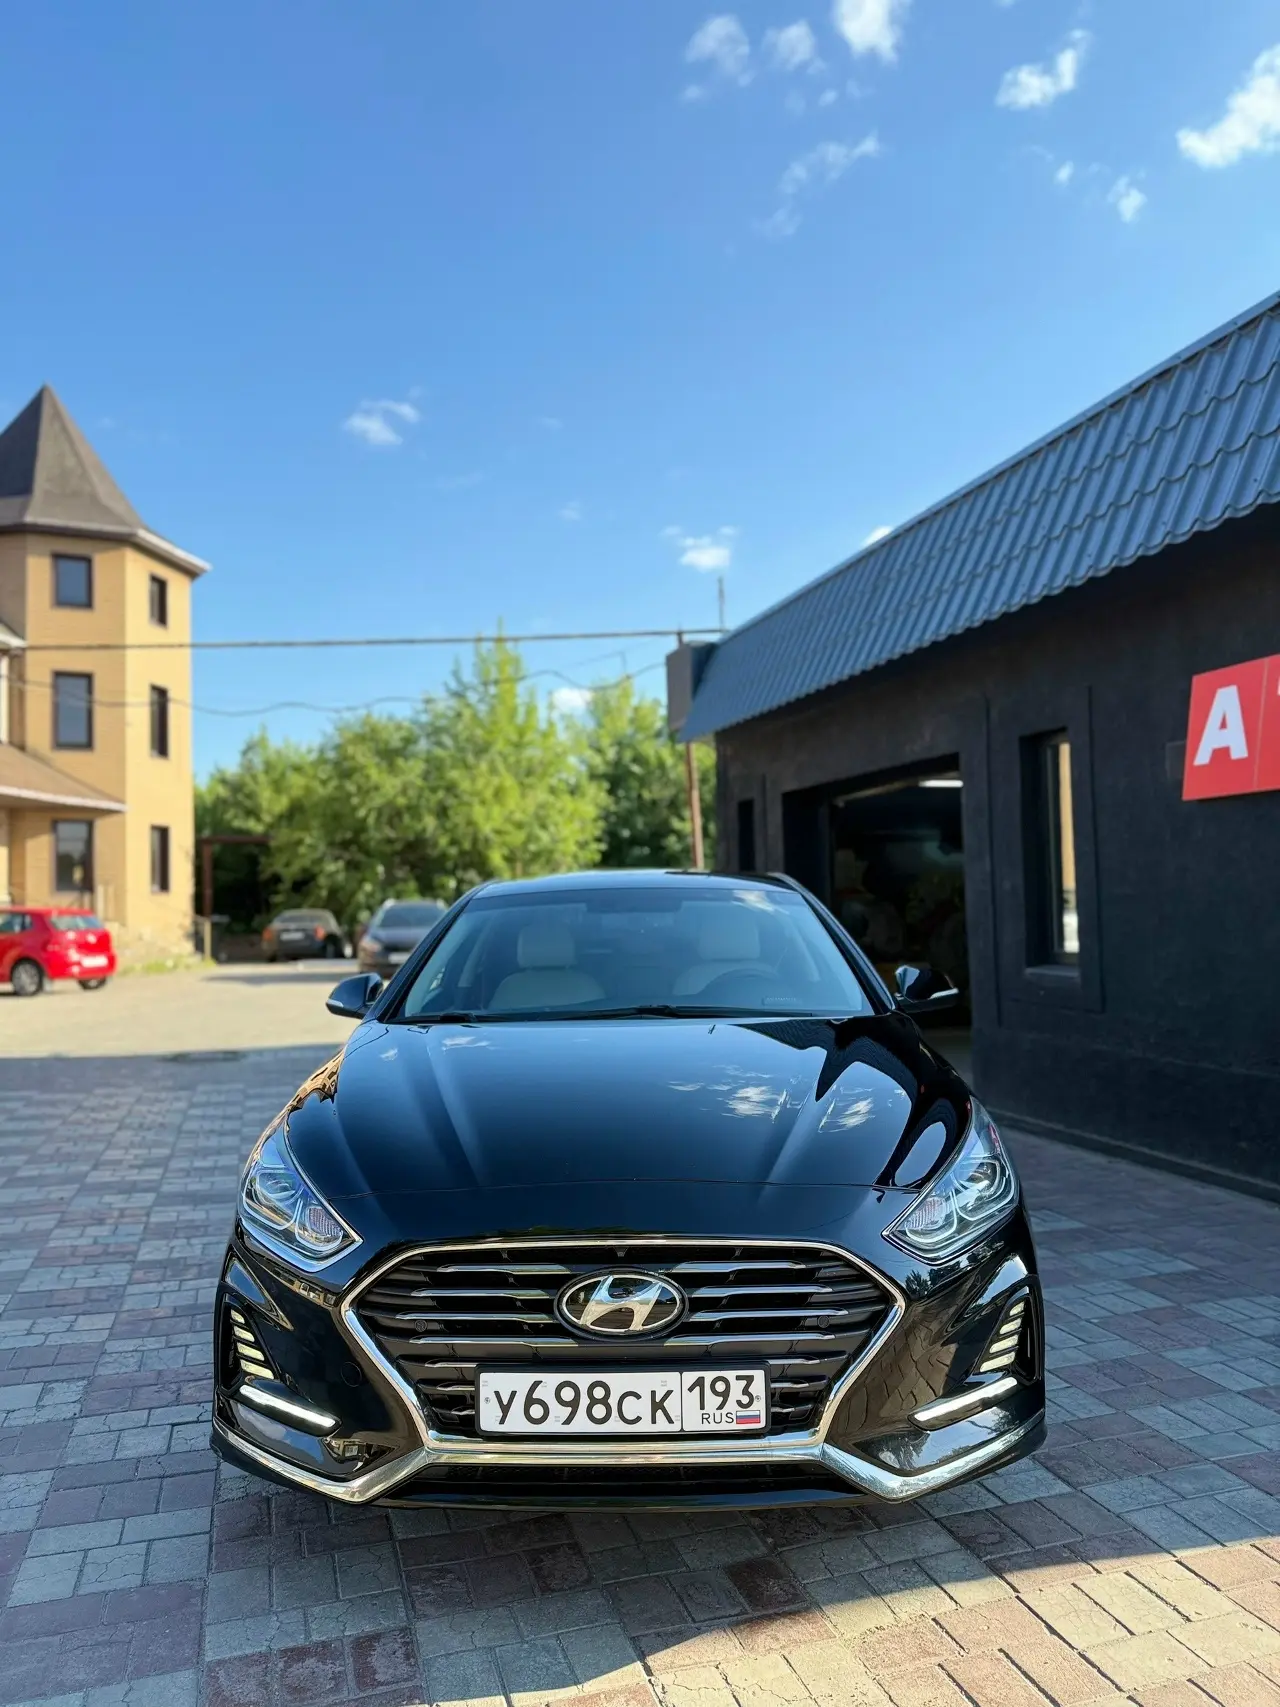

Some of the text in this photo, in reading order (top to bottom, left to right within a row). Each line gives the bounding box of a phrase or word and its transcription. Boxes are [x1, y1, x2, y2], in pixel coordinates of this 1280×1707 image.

[1193, 677, 1280, 766] А
[687, 1374, 755, 1411] 193
[701, 1412, 735, 1425] RUS
